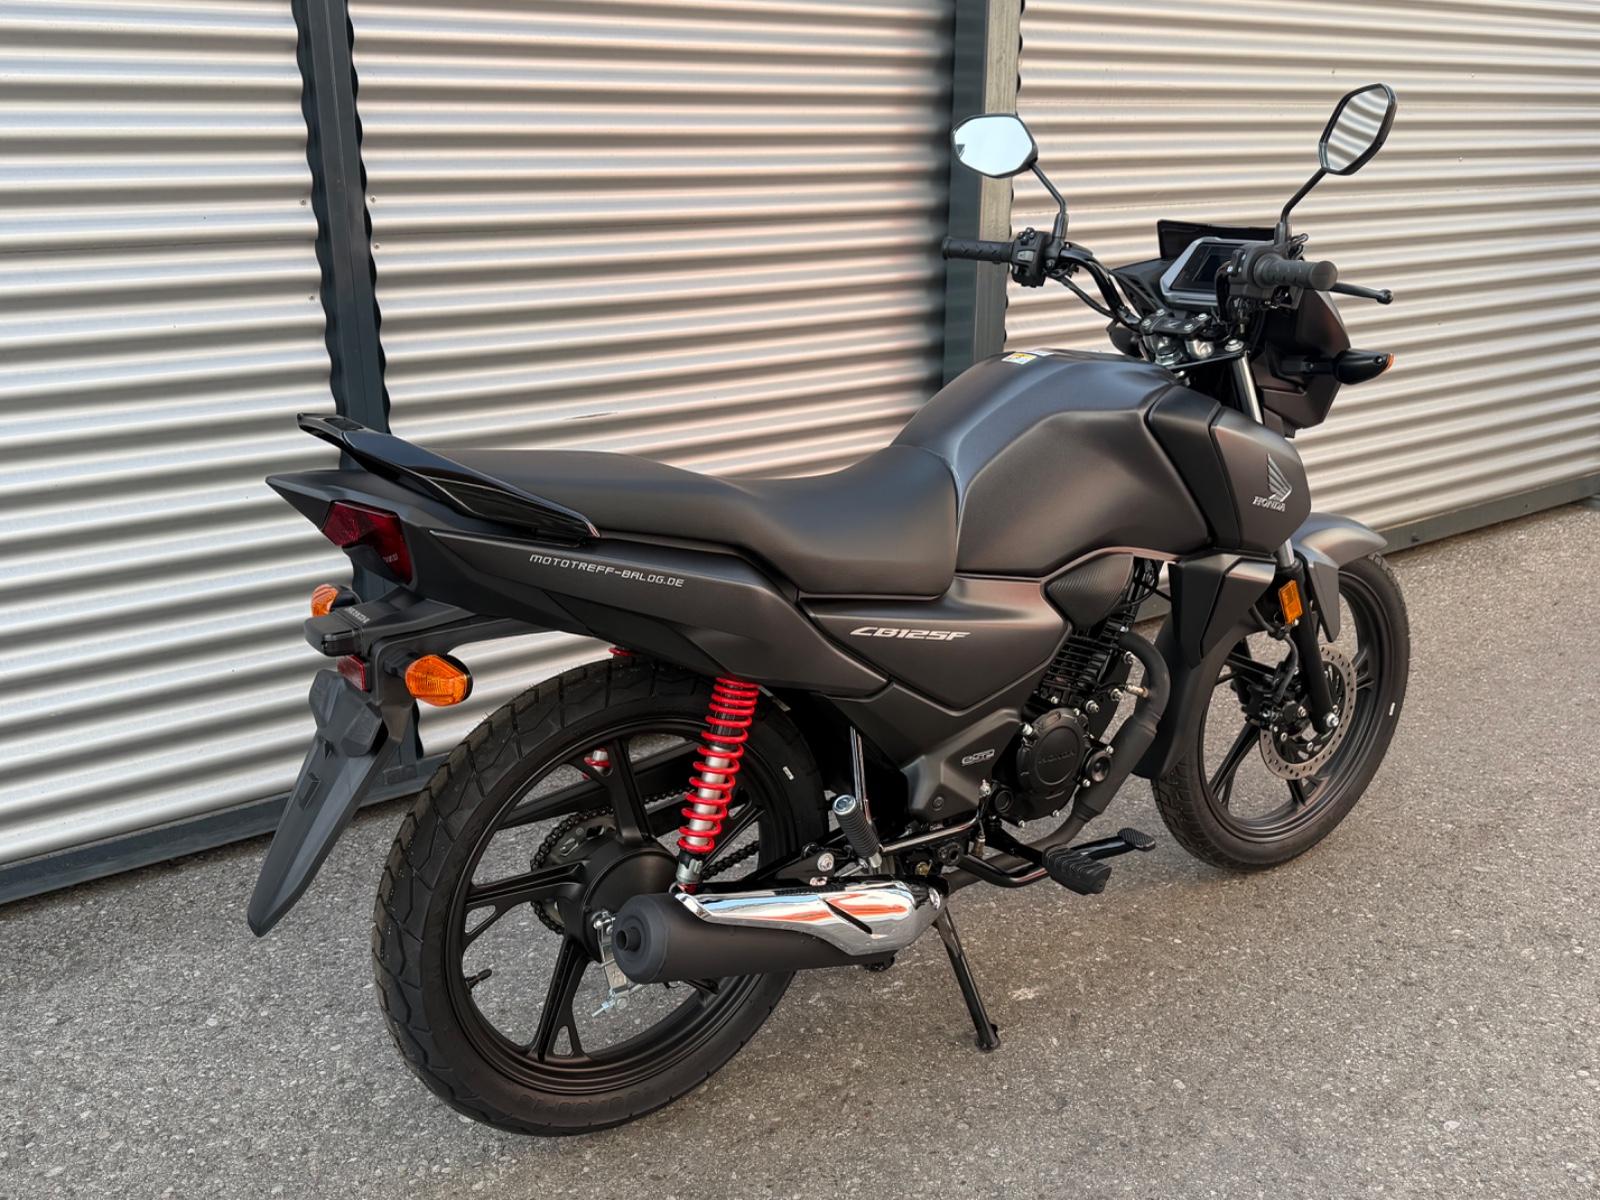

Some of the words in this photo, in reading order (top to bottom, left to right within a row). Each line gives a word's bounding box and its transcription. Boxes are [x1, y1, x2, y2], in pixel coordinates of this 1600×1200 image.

[1252, 496, 1286, 512] HONDA
[529, 553, 685, 588] MOTOTREFF-BALOG.DE
[849, 626, 971, 641] CB125F
